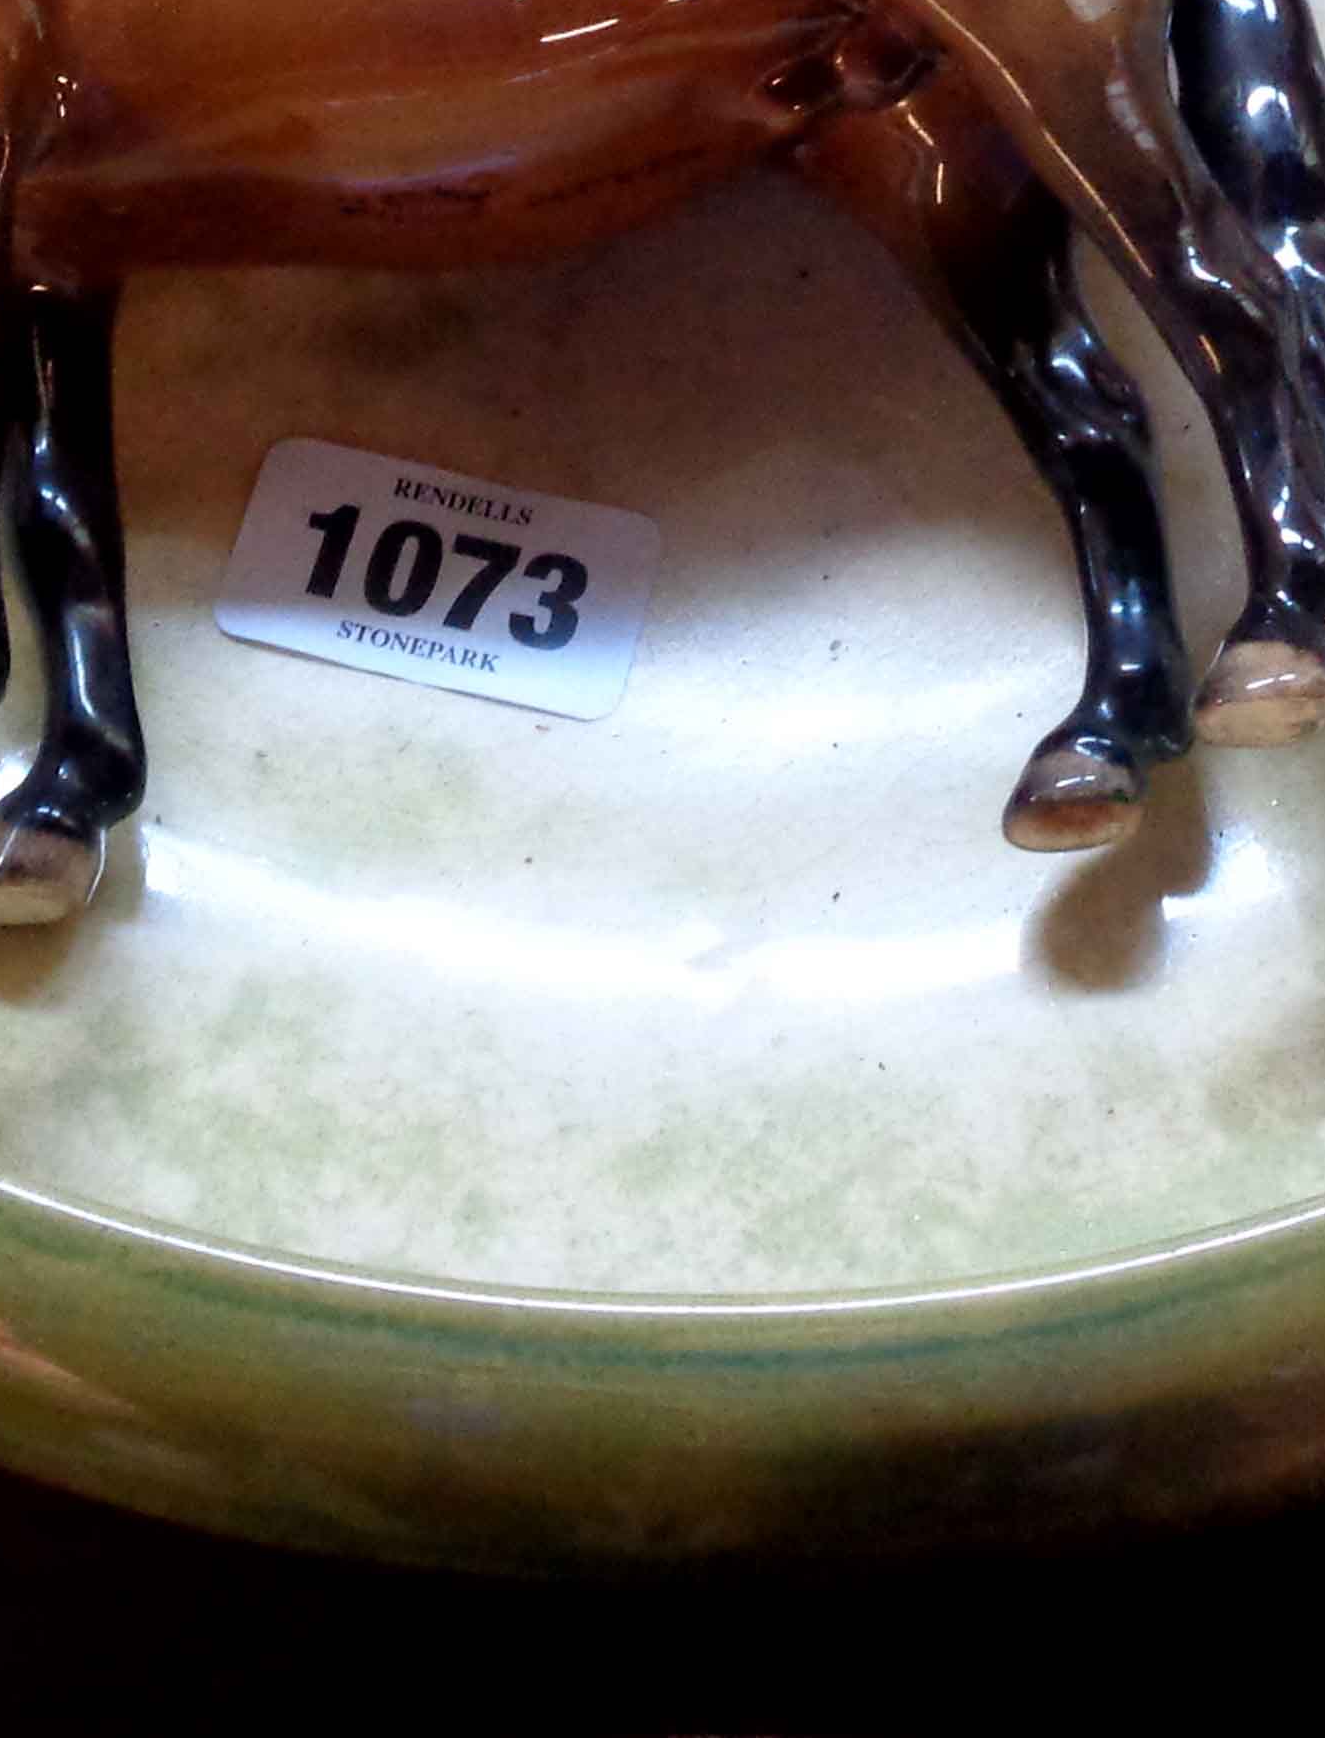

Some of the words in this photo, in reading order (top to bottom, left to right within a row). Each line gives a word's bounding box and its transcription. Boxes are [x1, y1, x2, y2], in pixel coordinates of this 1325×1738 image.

[393, 478, 534, 527] RENDELLS
[305, 504, 589, 652] 1073
[336, 619, 500, 674] STONEPARK
